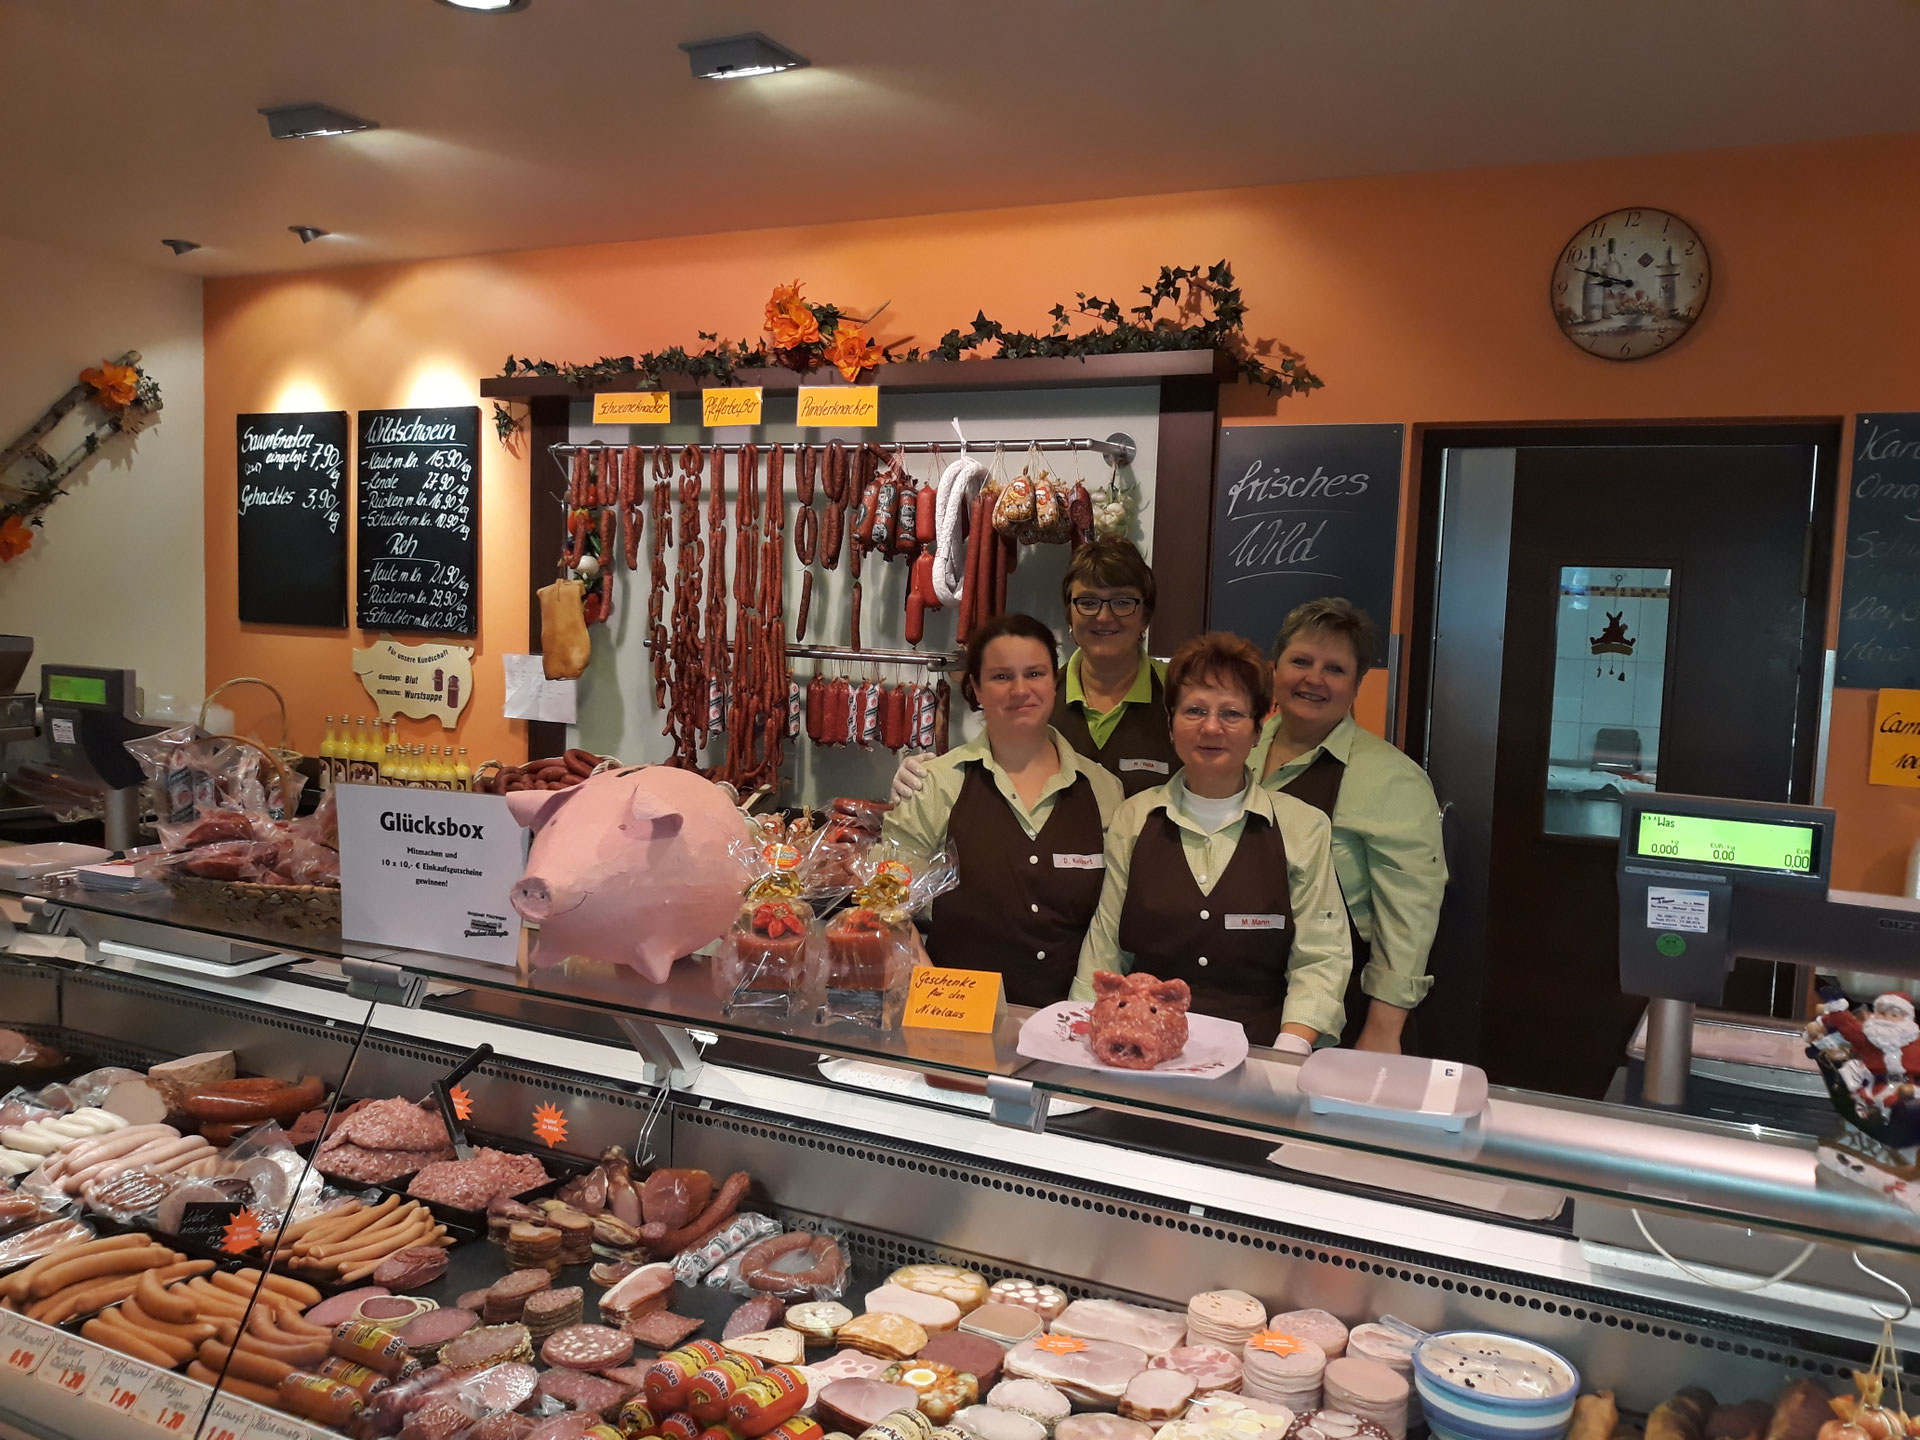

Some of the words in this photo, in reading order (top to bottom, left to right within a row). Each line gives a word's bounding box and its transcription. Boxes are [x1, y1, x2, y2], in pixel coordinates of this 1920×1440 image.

[1625, 211, 1642, 227] 12
[1662, 218, 1670, 234] 1
[1591, 223, 1606, 239] 11
[1566, 248, 1583, 265] 10
[1685, 240, 1696, 256] 2
[1558, 282, 1569, 295] 9
[1620, 342, 1631, 356] 6
[801, 396, 874, 417] Rinderknacker
[364, 415, 456, 444] Wildschwein
[265, 448, 308, 471] eingelegt
[366, 471, 399, 491] Lende
[1227, 460, 1371, 516] frisches
[238, 484, 296, 516] Gehacktes
[368, 490, 405, 511] Rücken
[367, 511, 410, 528] Schulter
[386, 532, 418, 558] Reh
[1228, 518, 1329, 567] Wild
[368, 584, 407, 604] Rücken
[366, 606, 414, 625] Schulter
[387, 645, 397, 657] Für
[417, 649, 449, 664] Kundschaft
[405, 675, 418, 684] Blut
[404, 690, 443, 702] Wurstsuppe
[380, 811, 484, 840] Glücksbox
[406, 846, 443, 858] Mitmachen
[445, 851, 458, 859] und
[1651, 843, 1679, 856] 0,000
[1712, 849, 1735, 862] 0,00
[1784, 854, 1810, 869] 0,00
[422, 862, 483, 876] Einkaufsgutscheine
[415, 878, 448, 887] gewinnen!
[1251, 918, 1270, 926] Mann
[915, 971, 976, 989] Geschenke
[927, 987, 944, 999] für
[948, 989, 966, 1001] den
[915, 1003, 966, 1019] Nikolaus
